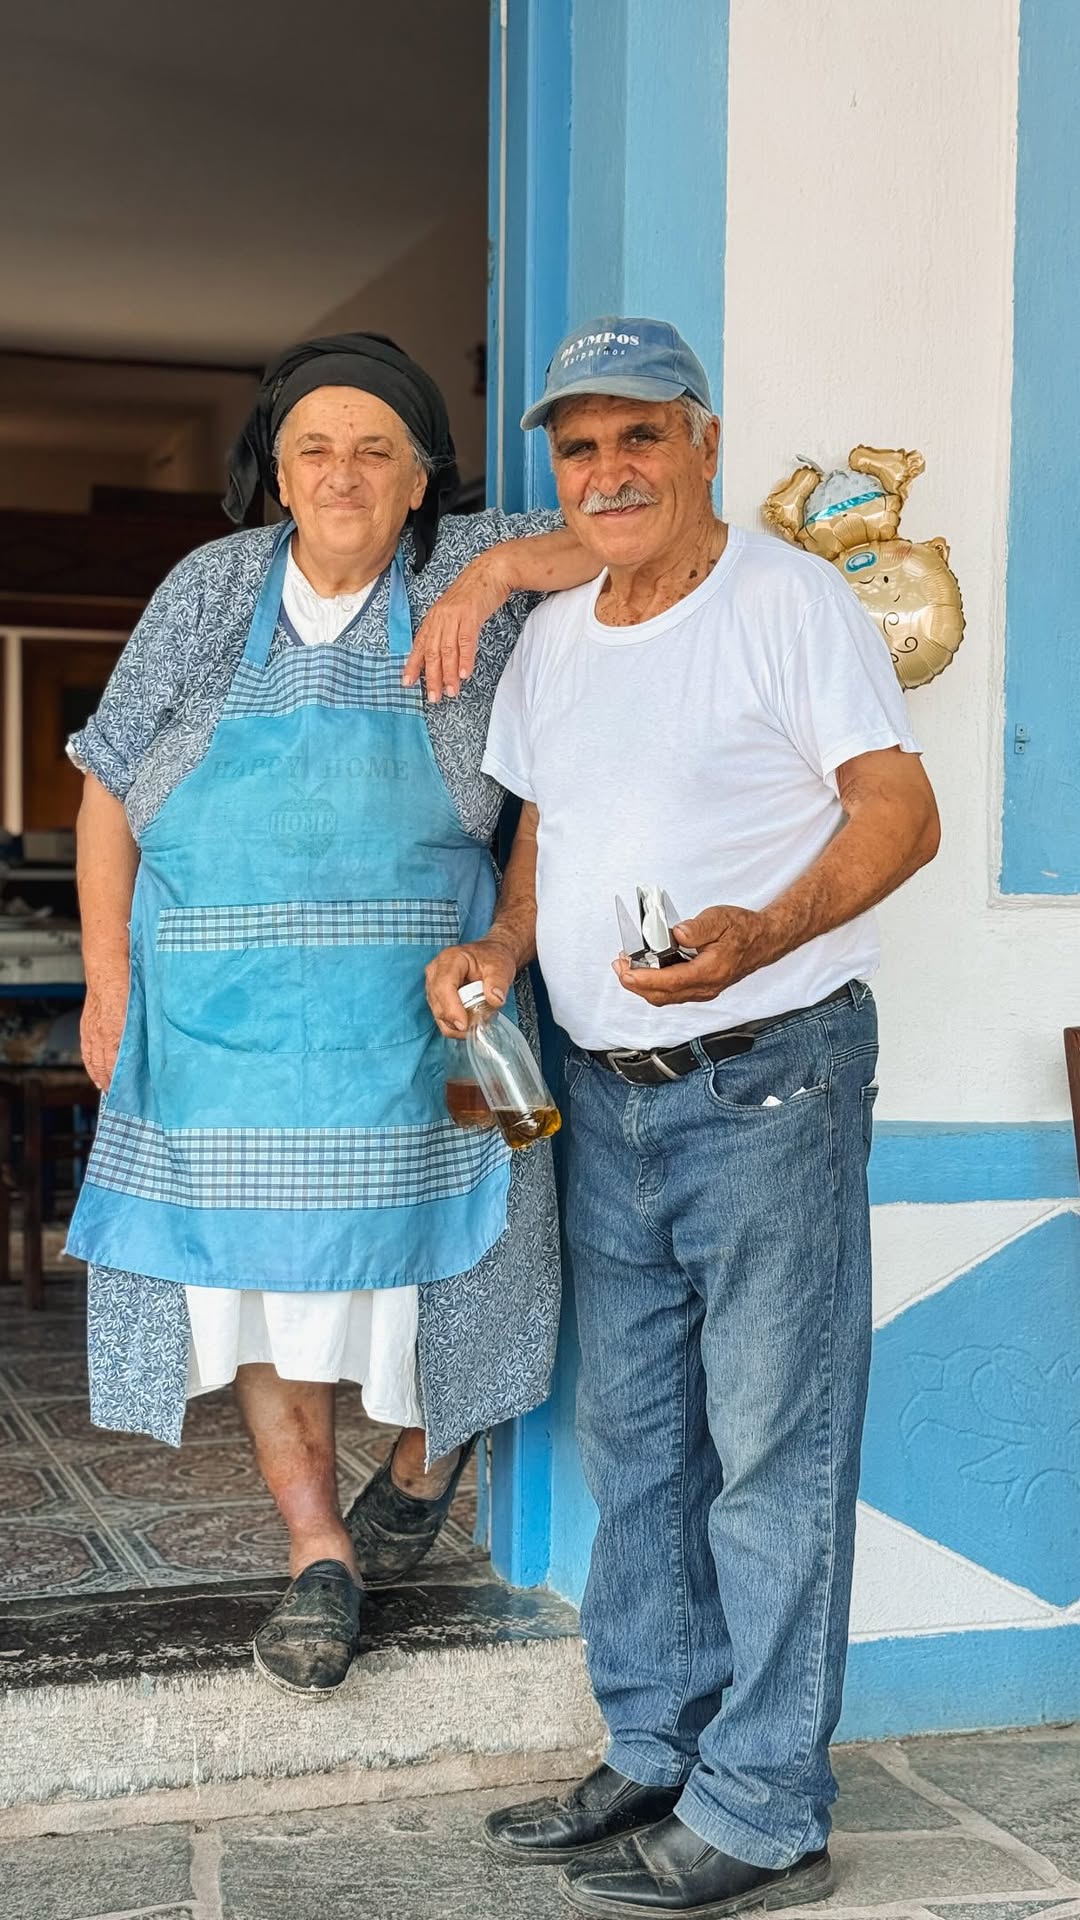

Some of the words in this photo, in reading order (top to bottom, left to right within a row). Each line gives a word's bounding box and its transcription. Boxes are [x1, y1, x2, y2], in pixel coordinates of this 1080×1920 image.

[211, 756, 304, 779] HAPPY
[323, 756, 409, 781] HOME
[271, 811, 336, 833] HOME
